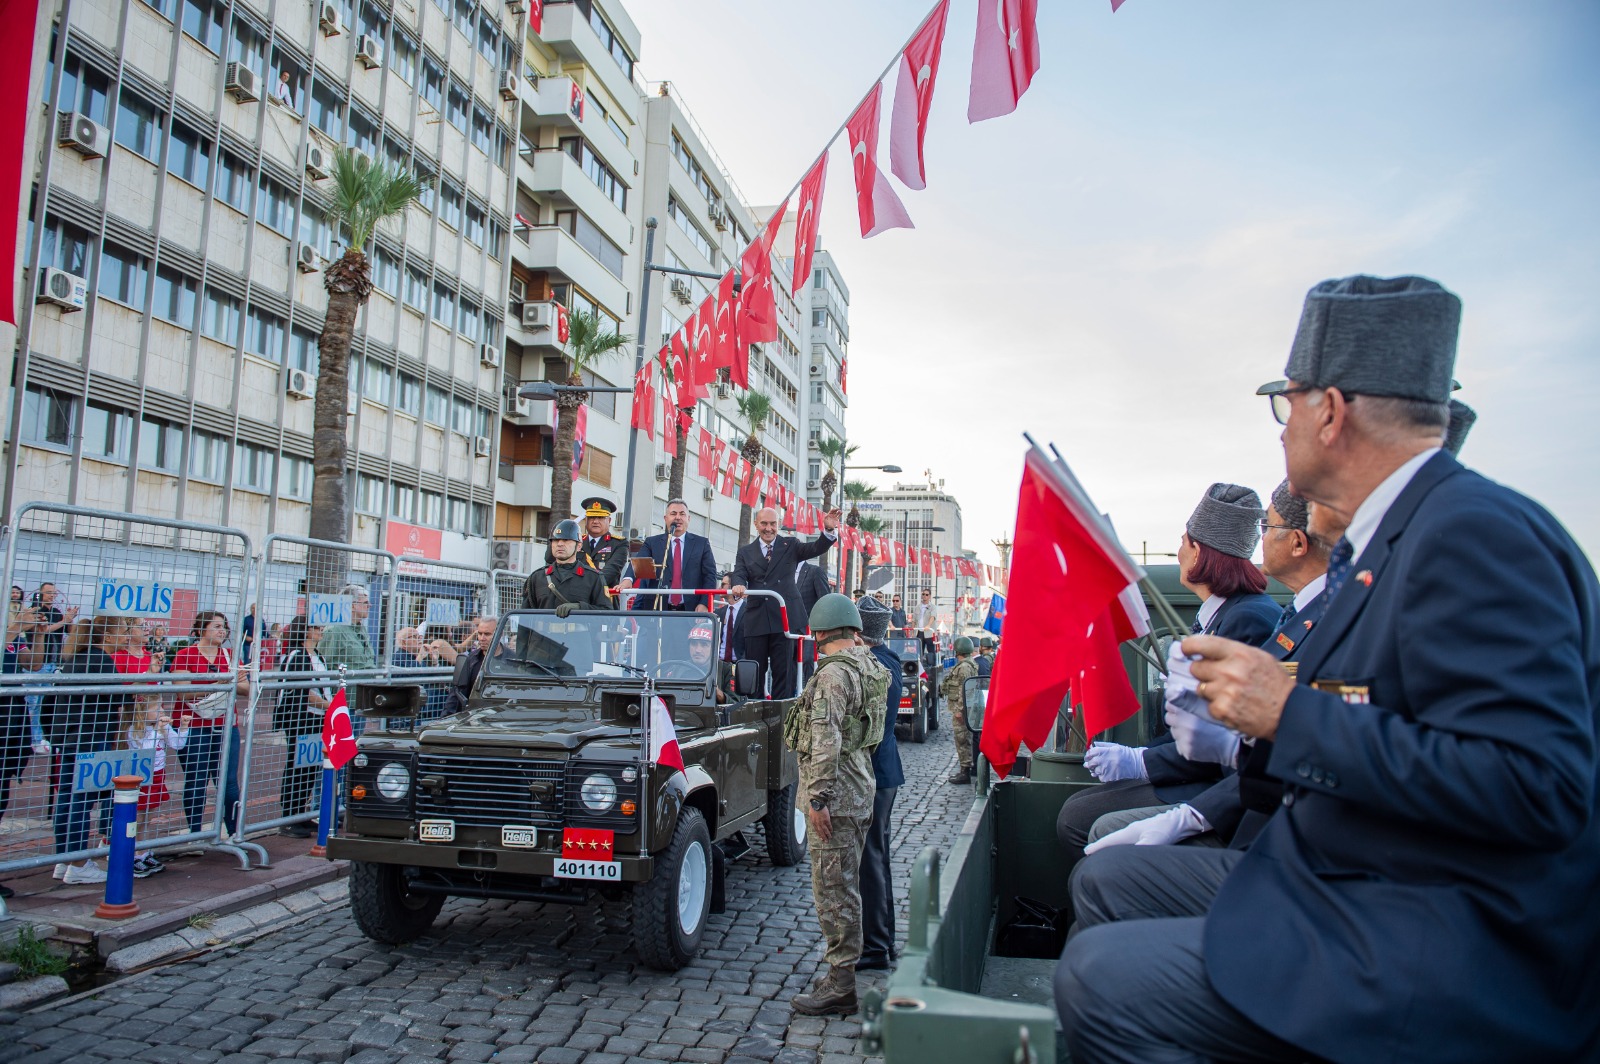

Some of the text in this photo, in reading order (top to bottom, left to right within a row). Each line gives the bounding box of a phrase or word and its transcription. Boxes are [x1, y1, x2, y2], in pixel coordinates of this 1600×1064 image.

[98, 583, 171, 613] POLİS
[423, 825, 450, 836] Hella
[505, 831, 532, 842] Hella
[558, 861, 617, 878] 401110
